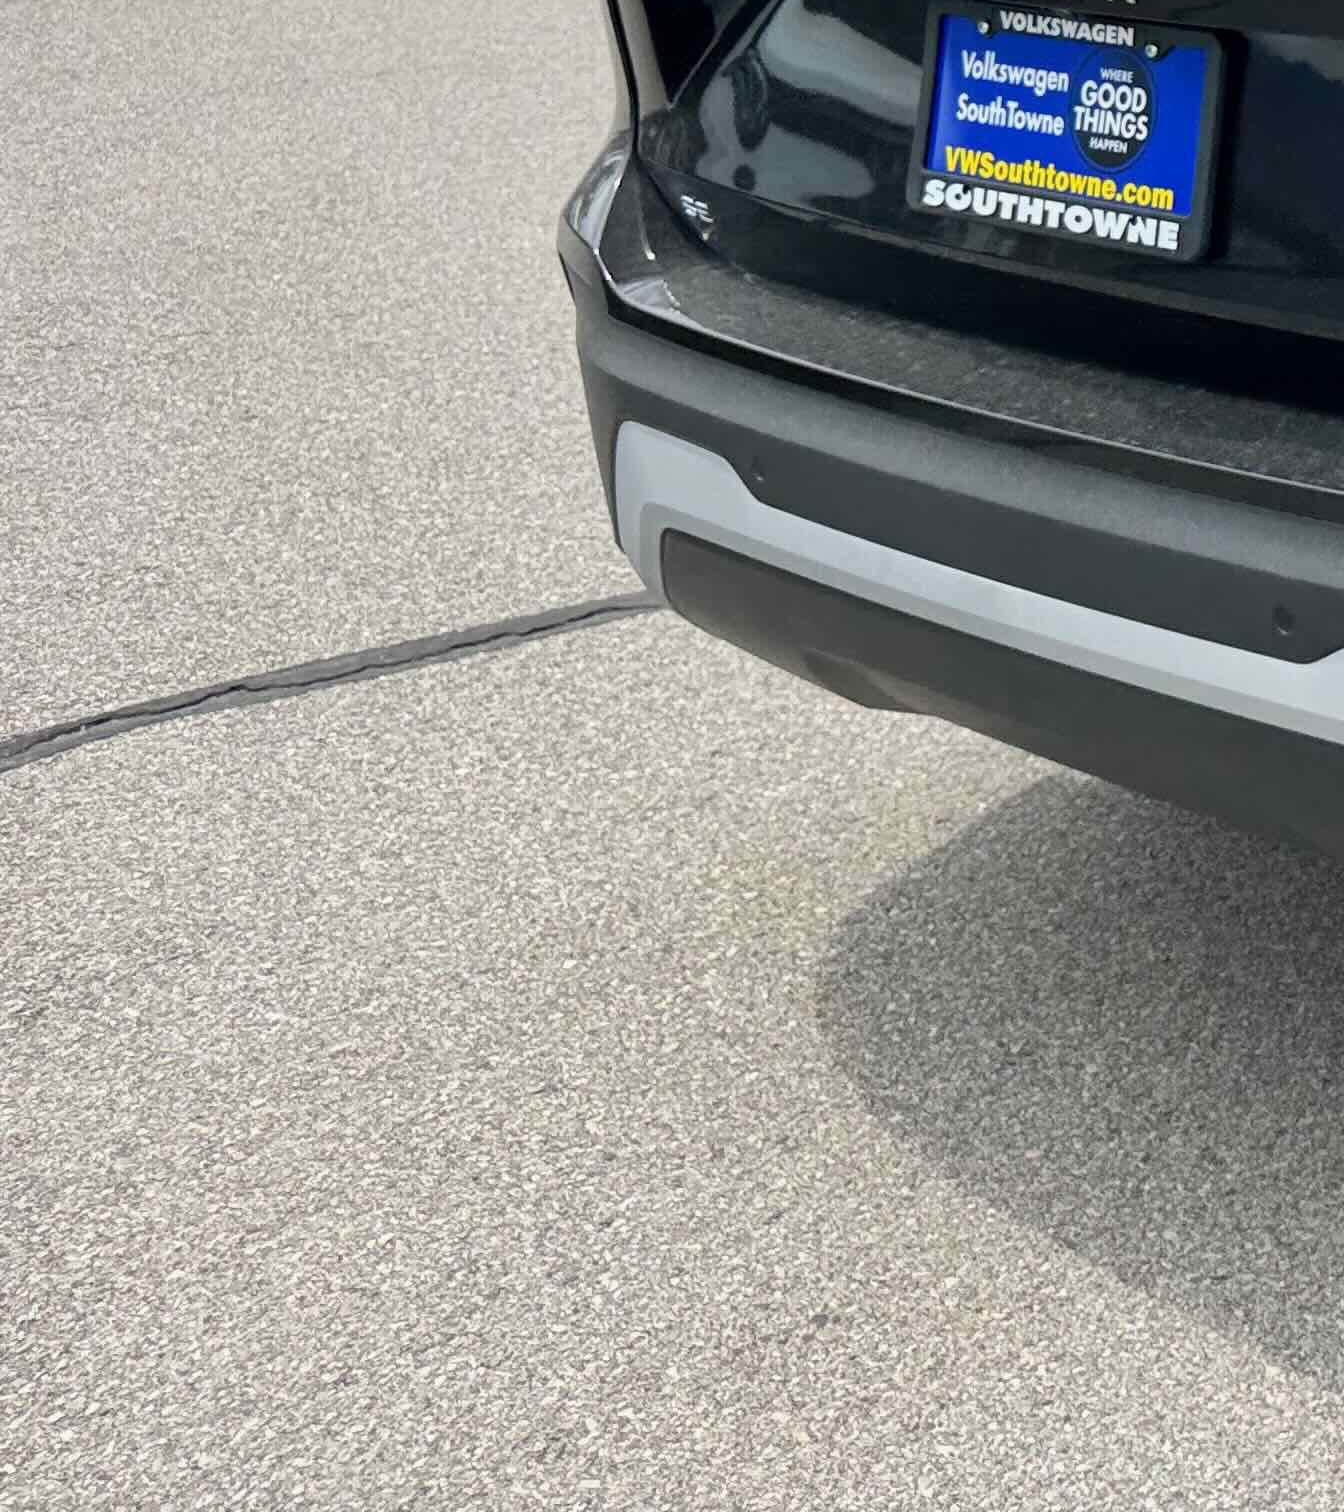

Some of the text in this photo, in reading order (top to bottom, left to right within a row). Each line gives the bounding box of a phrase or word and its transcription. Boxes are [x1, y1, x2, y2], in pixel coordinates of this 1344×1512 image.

[999, 10, 1136, 48] VOLKSWAGEN
[960, 49, 1070, 94] Volkswagen
[1099, 66, 1135, 83] WHERE
[955, 93, 1065, 138] SouthTowne
[1080, 79, 1148, 115] GOOD
[1073, 105, 1149, 142] THINGS
[1088, 136, 1128, 155] HAPPEN
[944, 144, 1175, 212] VWSouthtowne.com
[921, 178, 1181, 252] SOUTHTOWNE
